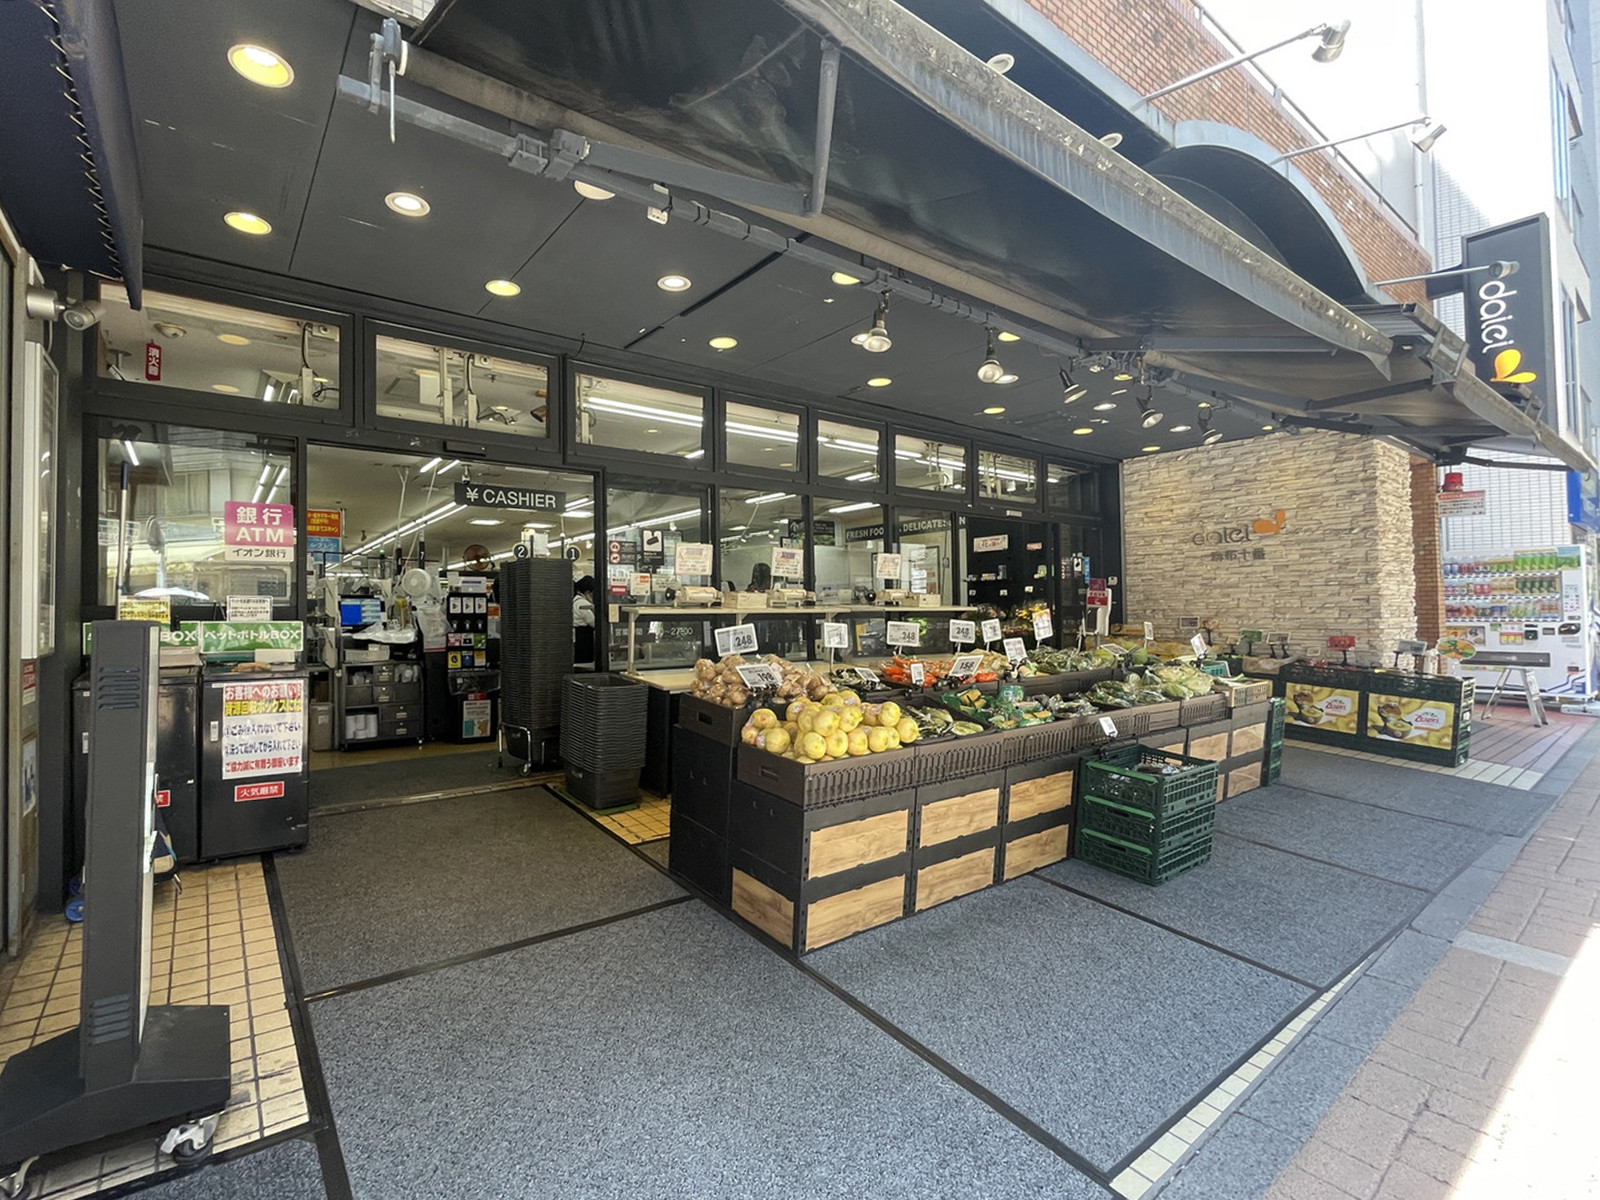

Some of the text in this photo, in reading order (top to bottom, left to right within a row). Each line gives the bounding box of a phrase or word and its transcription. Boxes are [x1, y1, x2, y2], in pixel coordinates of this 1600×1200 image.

[1479, 280, 1517, 354] daiei
[483, 489, 556, 508] CASHIER
[236, 506, 283, 526] 銀行
[235, 526, 285, 543] ATM
[846, 529, 868, 540] FRESH
[869, 527, 884, 537] FOO
[232, 548, 287, 558] イオン銀行
[517, 546, 525, 558] 2
[204, 629, 301, 641] ペットボトルBOX
[735, 635, 753, 647] 248
[901, 631, 916, 641] 248
[757, 672, 774, 682] 198
[240, 785, 279, 798] 火気厳禁
